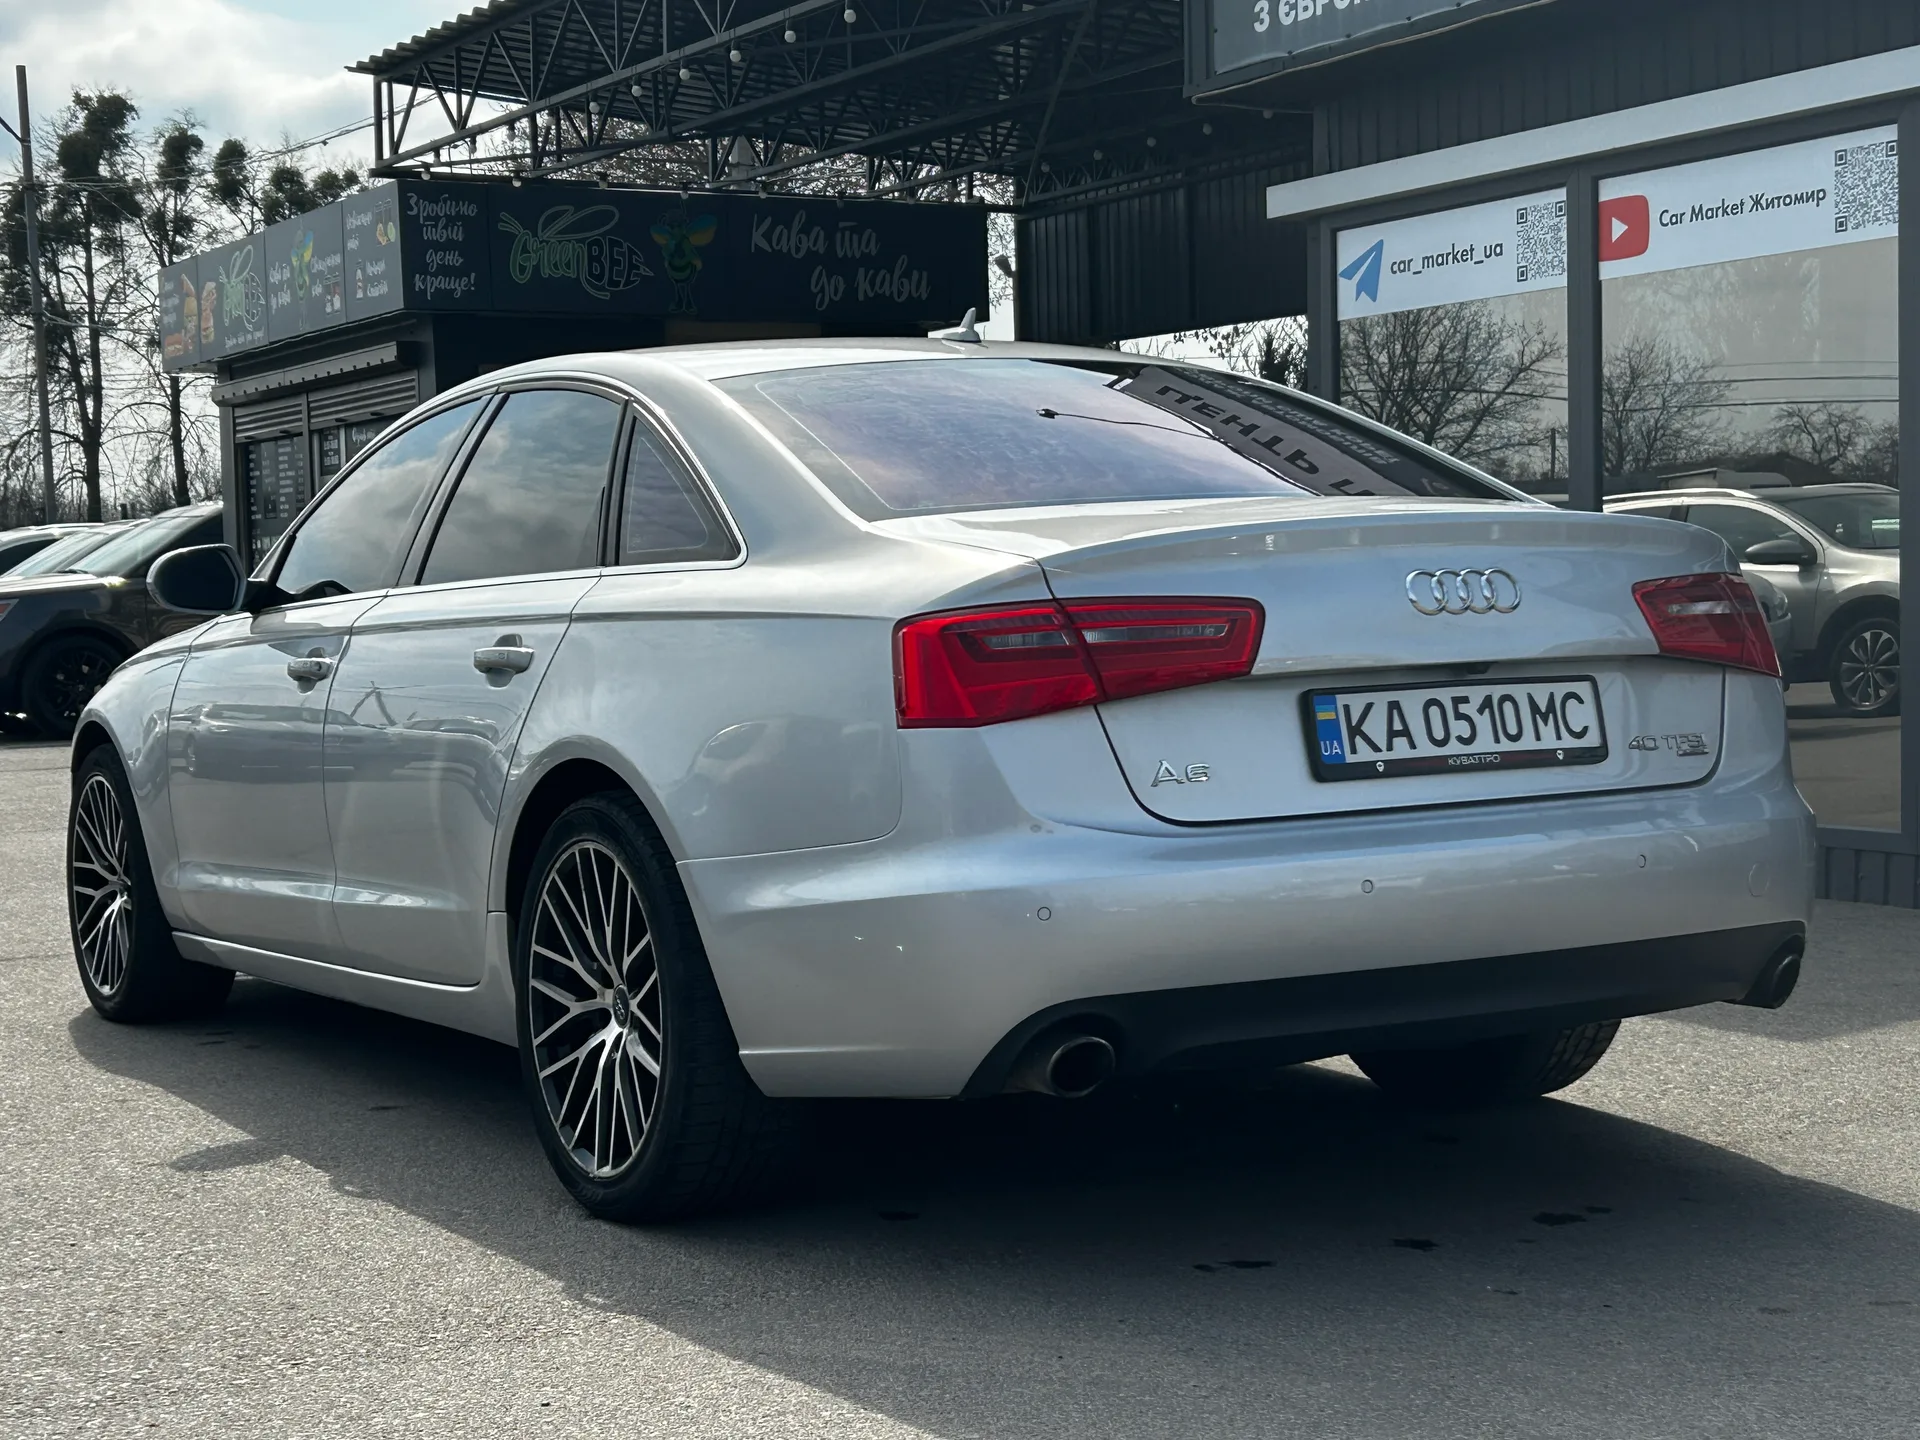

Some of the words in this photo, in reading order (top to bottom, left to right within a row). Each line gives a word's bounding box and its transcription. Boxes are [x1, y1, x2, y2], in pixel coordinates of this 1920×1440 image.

[407, 193, 478, 223] Зробимо
[1658, 209, 1686, 227] Car
[1689, 198, 1745, 223] Market
[1748, 188, 1827, 214] Житомир
[422, 220, 464, 242] твій
[751, 210, 829, 259] Кава
[836, 221, 881, 259] та
[425, 249, 464, 272] день
[1390, 243, 1504, 275] car_market_ua
[414, 272, 476, 300] краще!
[810, 265, 846, 311] до
[854, 255, 932, 303] кави
[1342, 700, 1418, 755] KA
[1422, 693, 1524, 748] 0510
[1527, 691, 1590, 742] MC
[1320, 740, 1342, 757] UA
[1150, 759, 1211, 788] A6
